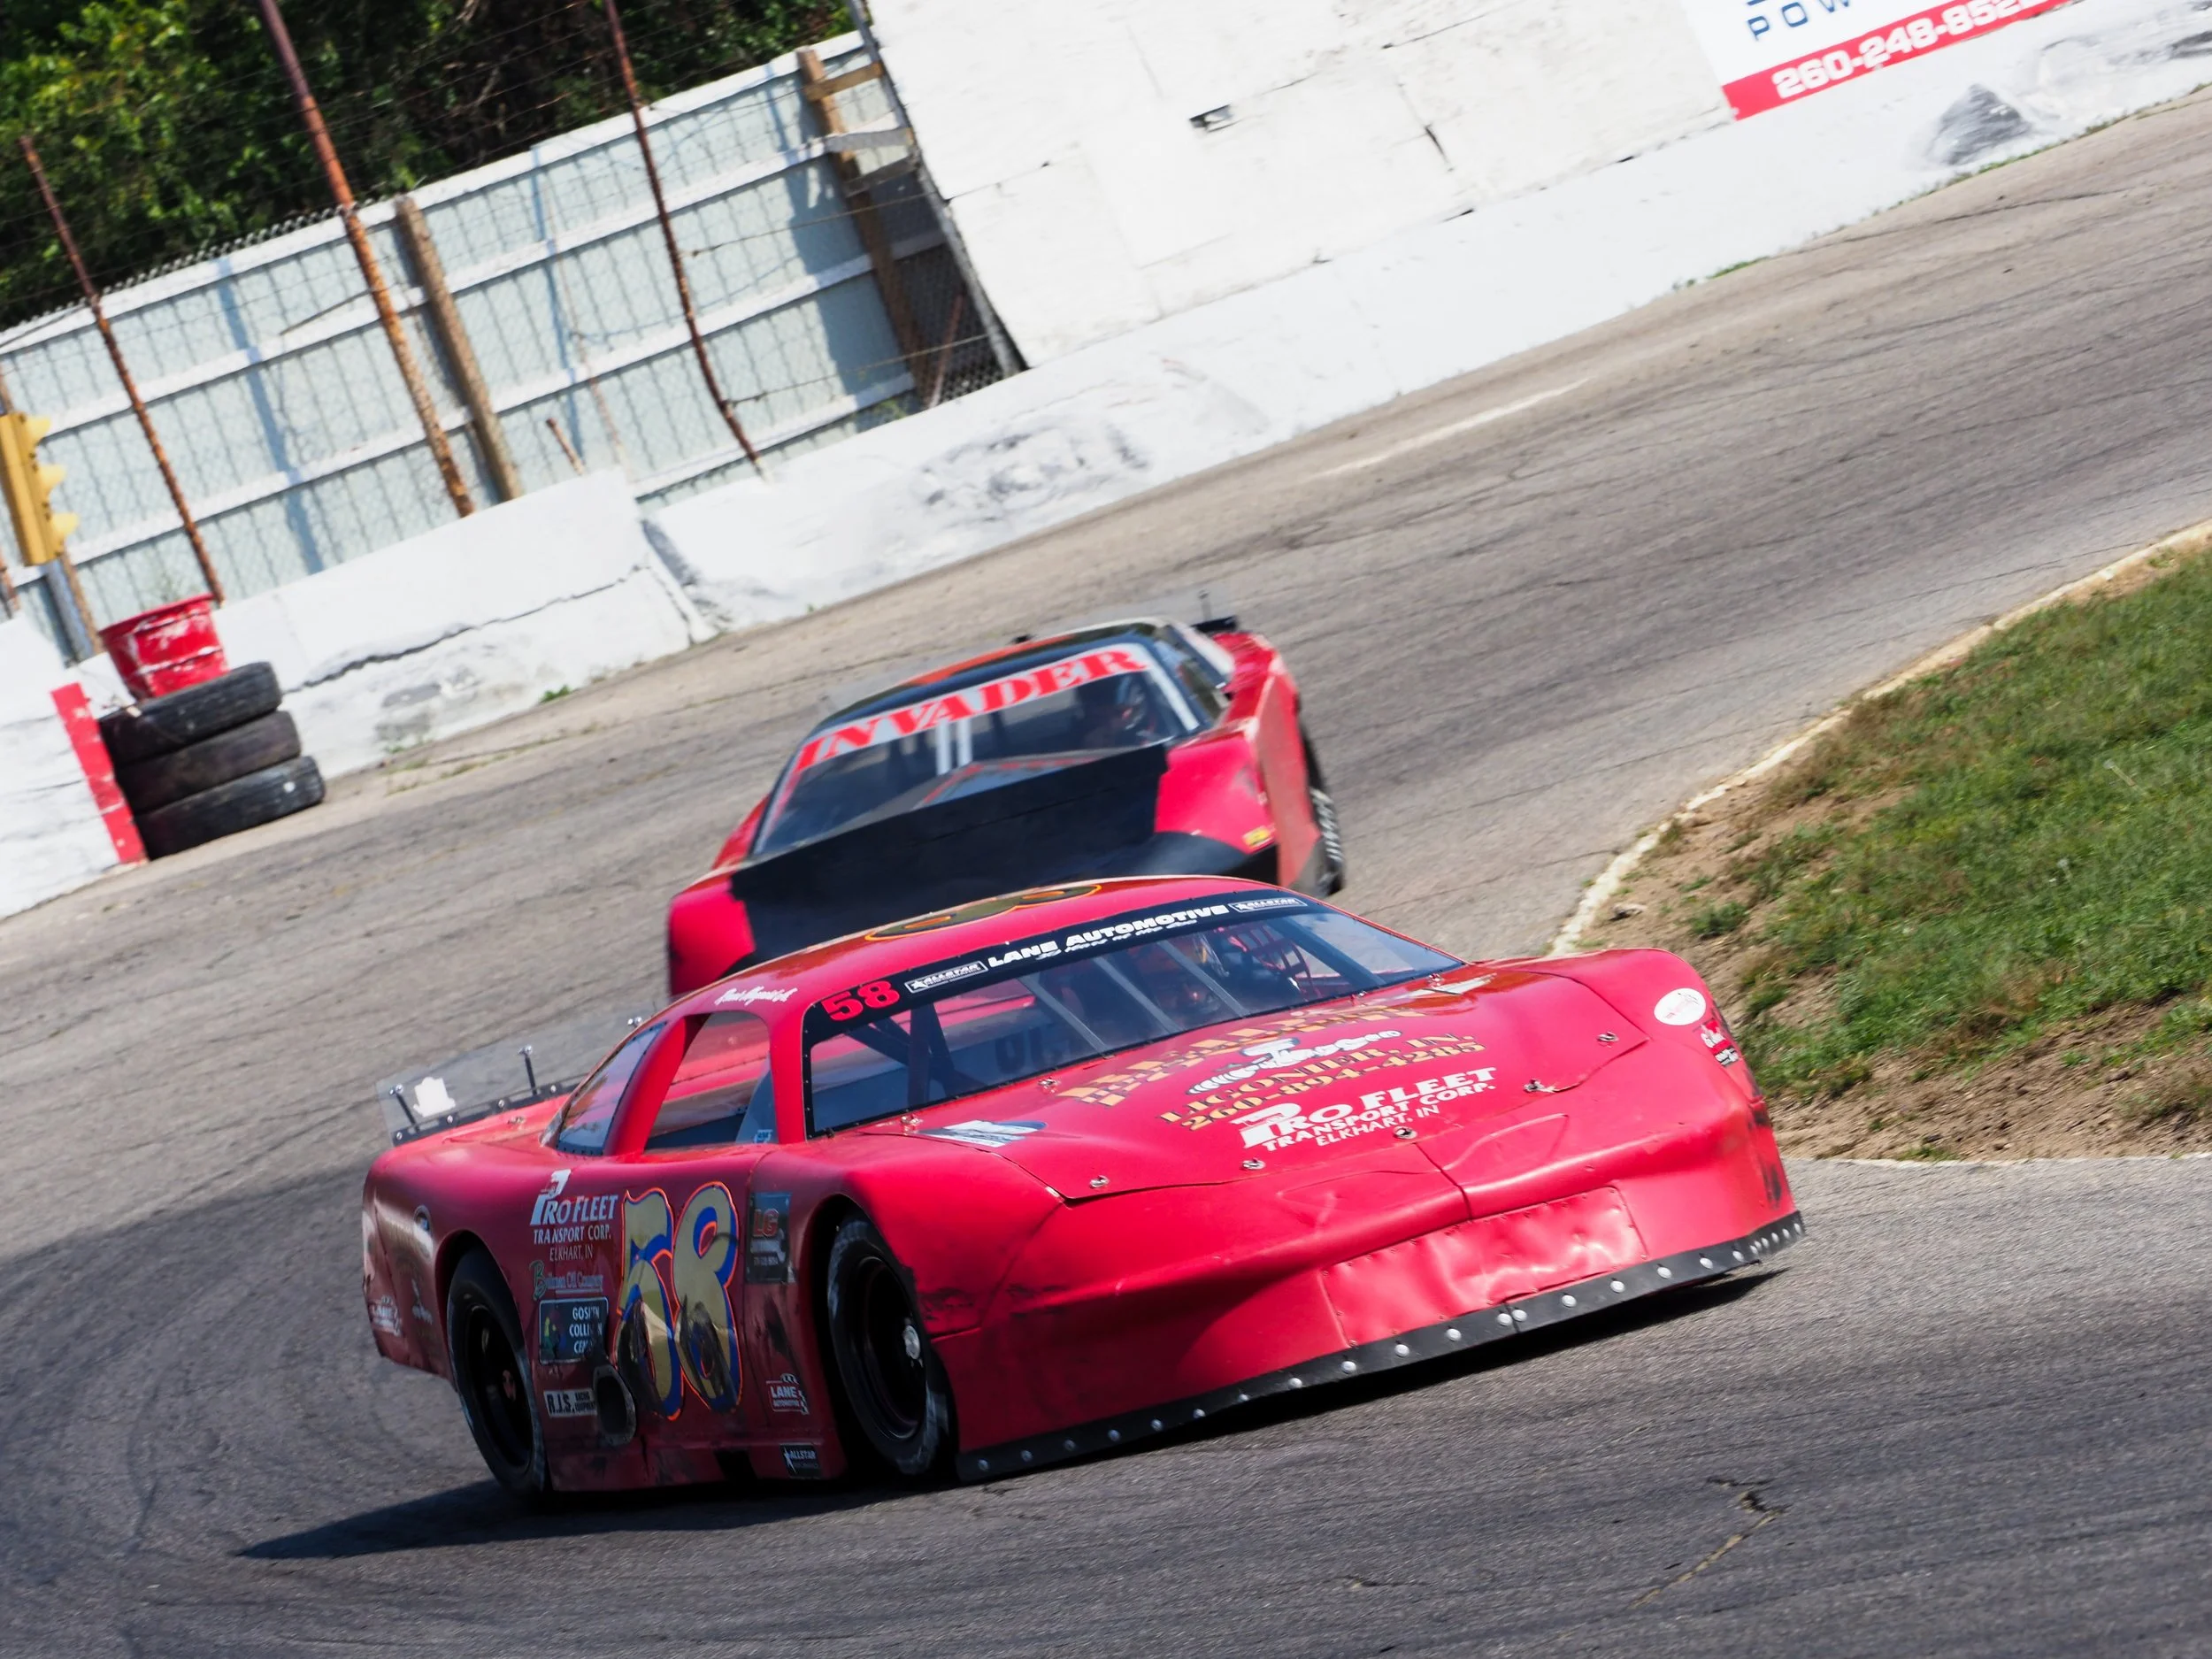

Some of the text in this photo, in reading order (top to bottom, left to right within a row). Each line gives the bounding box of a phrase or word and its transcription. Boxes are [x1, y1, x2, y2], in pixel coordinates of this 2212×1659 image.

[1772, 0, 2049, 99] 260-248-852
[796, 650, 1148, 772] INVADER
[987, 941, 1059, 968] LANE
[1065, 905, 1230, 946] AUTOMOTIVE
[821, 980, 901, 1021] 58
[1158, 1048, 1402, 1123] LIGONIER,
[1181, 1041, 1487, 1132] 260-894-4285
[1360, 1067, 1497, 1110] FLEET
[1263, 1082, 1497, 1151] TRANSPORT CORP.
[1416, 1105, 1440, 1118] IN
[572, 1194, 618, 1223] FLEET
[753, 1209, 780, 1237] LG
[534, 1224, 611, 1245] TRANSPORT CORP.
[585, 1243, 594, 1258] IN
[616, 1181, 743, 1421] 58
[770, 1386, 798, 1399] LANE
